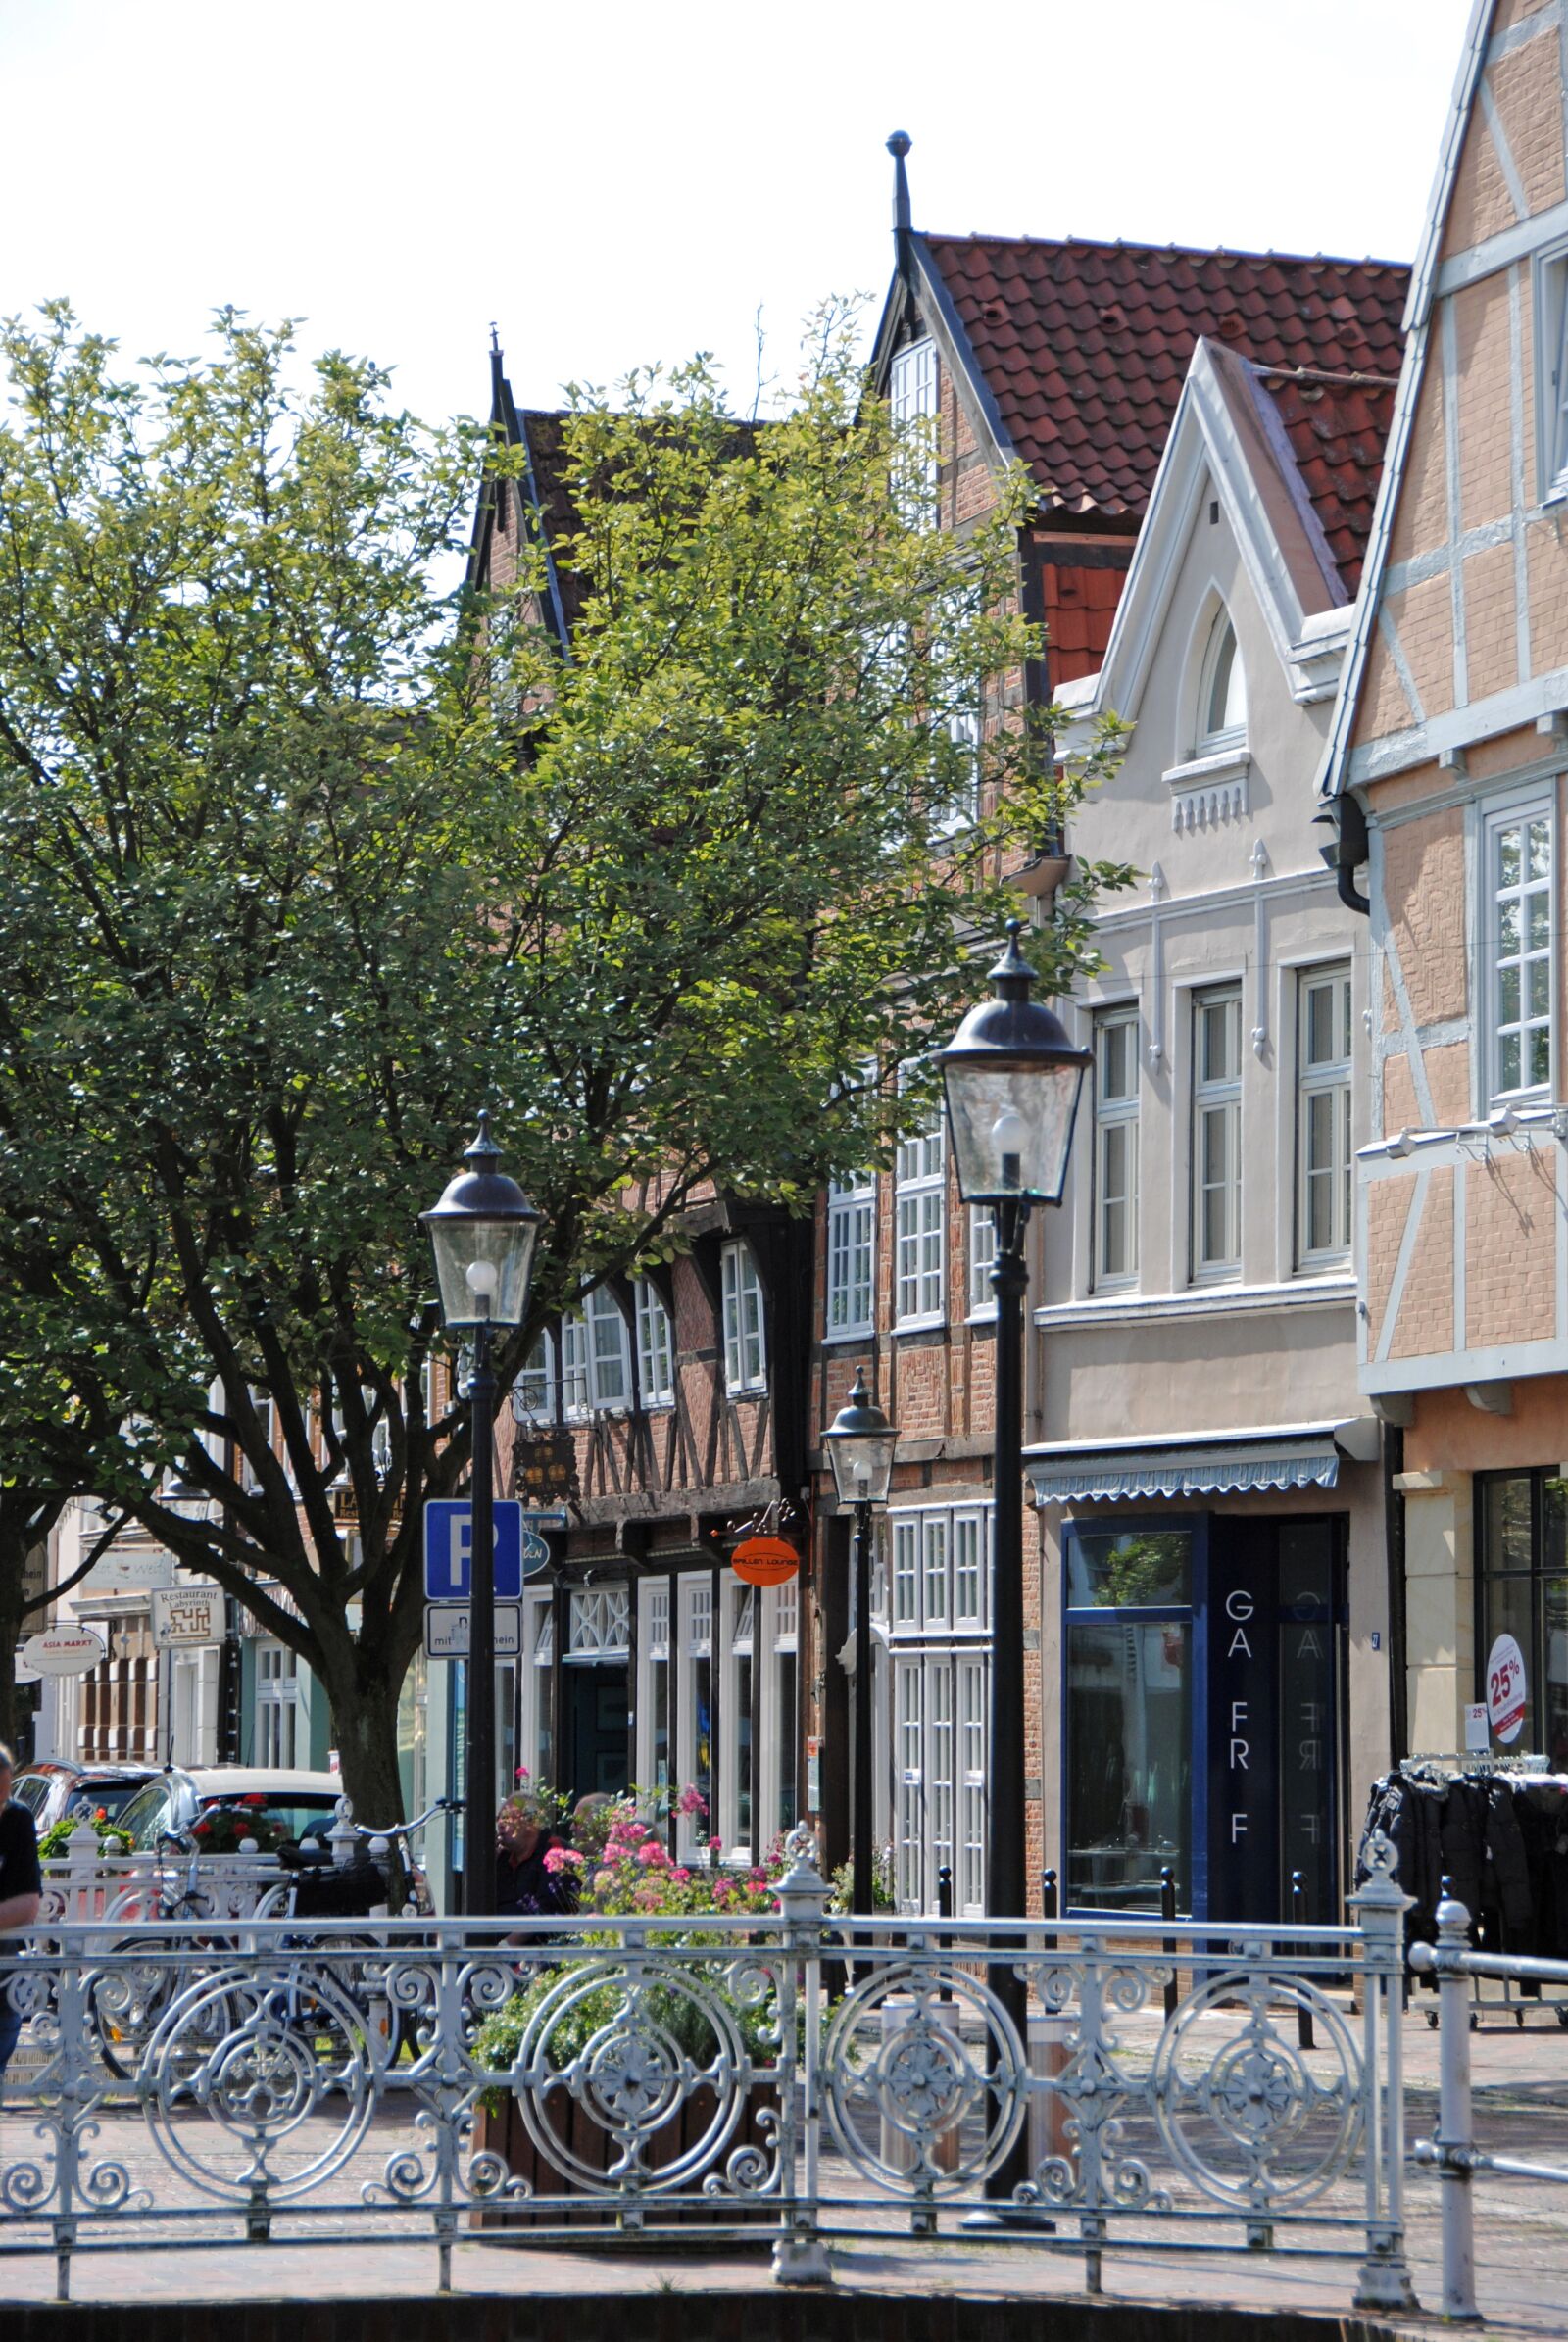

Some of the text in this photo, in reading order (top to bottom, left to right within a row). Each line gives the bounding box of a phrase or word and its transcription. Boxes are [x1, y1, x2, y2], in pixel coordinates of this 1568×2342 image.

[161, 1590, 218, 1603] Restaurant
[170, 1599, 210, 1608] Labyrinth
[434, 1635, 452, 1646] mit
[1491, 1656, 1519, 1707] 25%
